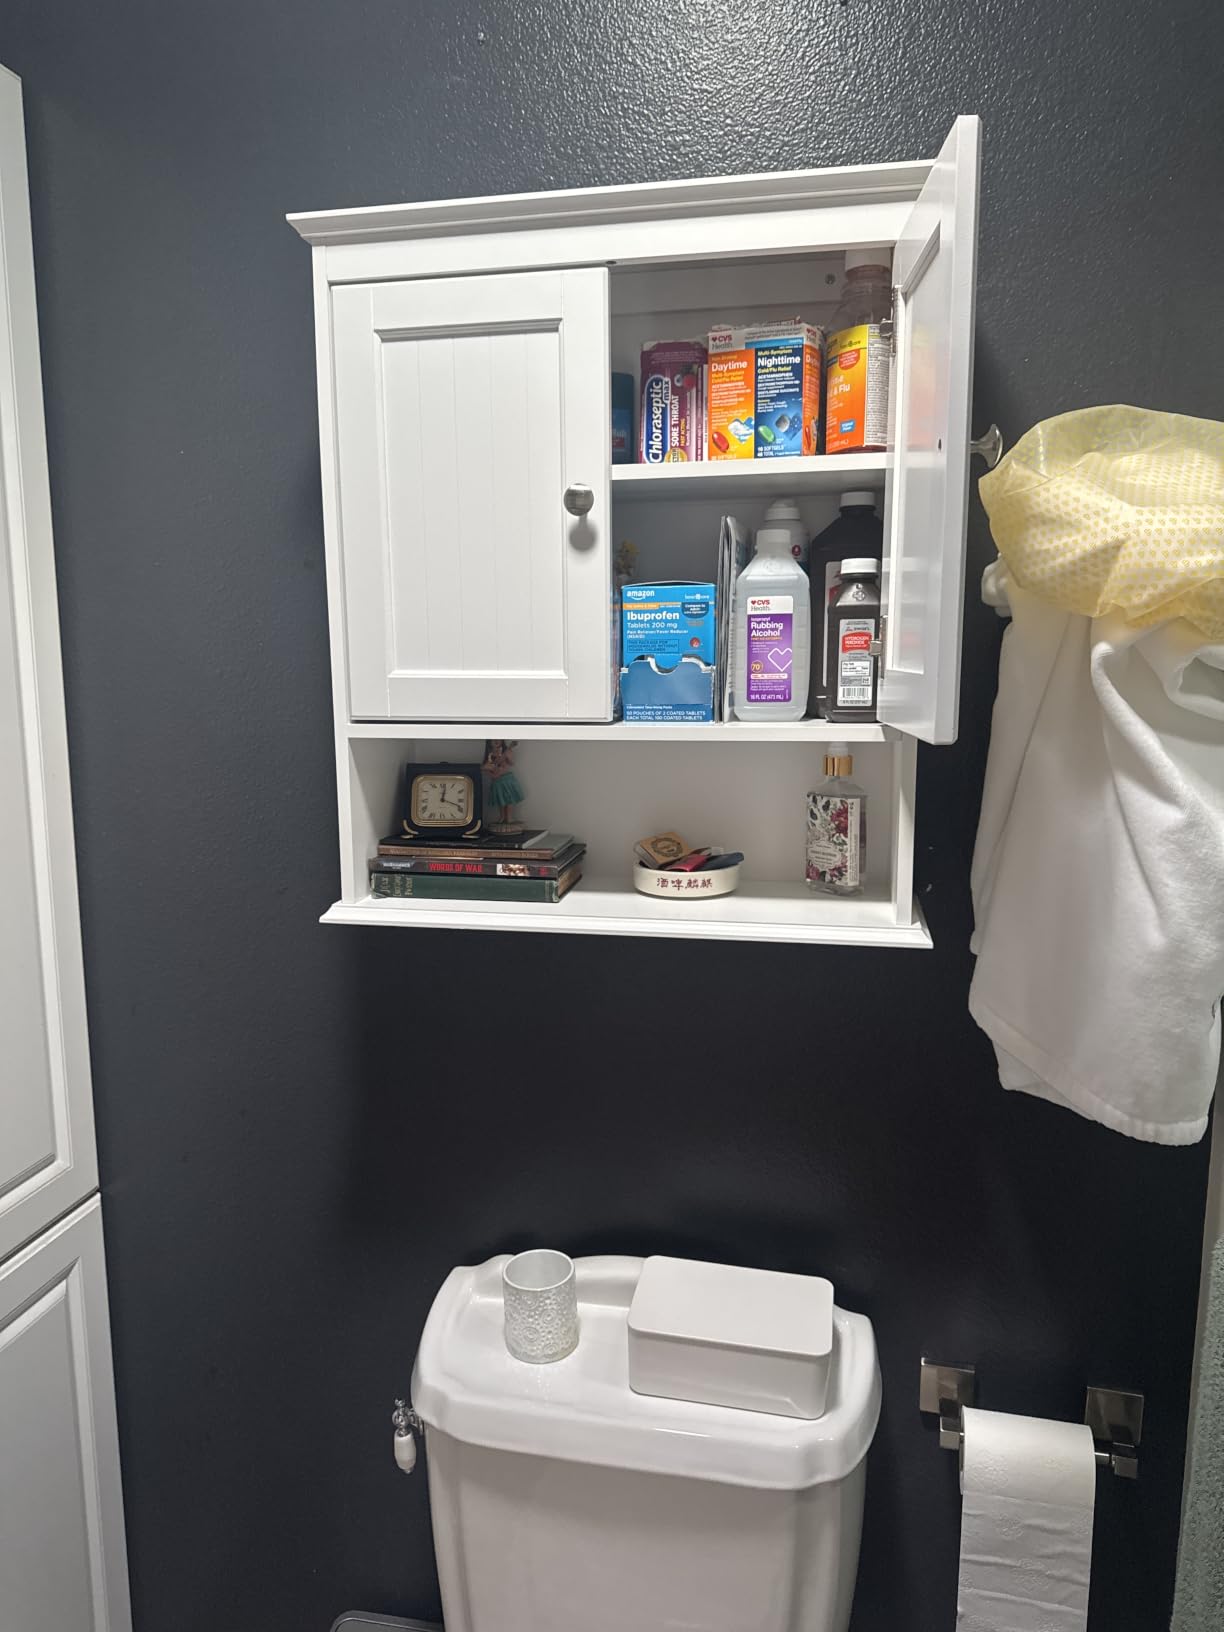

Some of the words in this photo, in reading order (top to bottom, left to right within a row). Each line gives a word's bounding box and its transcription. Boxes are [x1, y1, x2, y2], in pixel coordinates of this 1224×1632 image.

[716, 334, 733, 343] CVS
[711, 342, 733, 351] Health
[711, 360, 748, 372] Daytime
[757, 355, 801, 368] Nighttime
[663, 380, 671, 401] max
[671, 395, 680, 425] THROAT
[648, 381, 666, 463] Chloraseptic
[671, 427, 680, 447] SORE
[626, 590, 655, 599] amazon
[627, 611, 680, 621] Ibuprofen
[750, 621, 784, 630] Rubbing
[750, 629, 781, 637] Alcohol
[429, 863, 454, 872] WORDS
[455, 863, 463, 872] OF
[464, 864, 483, 873] WAR
